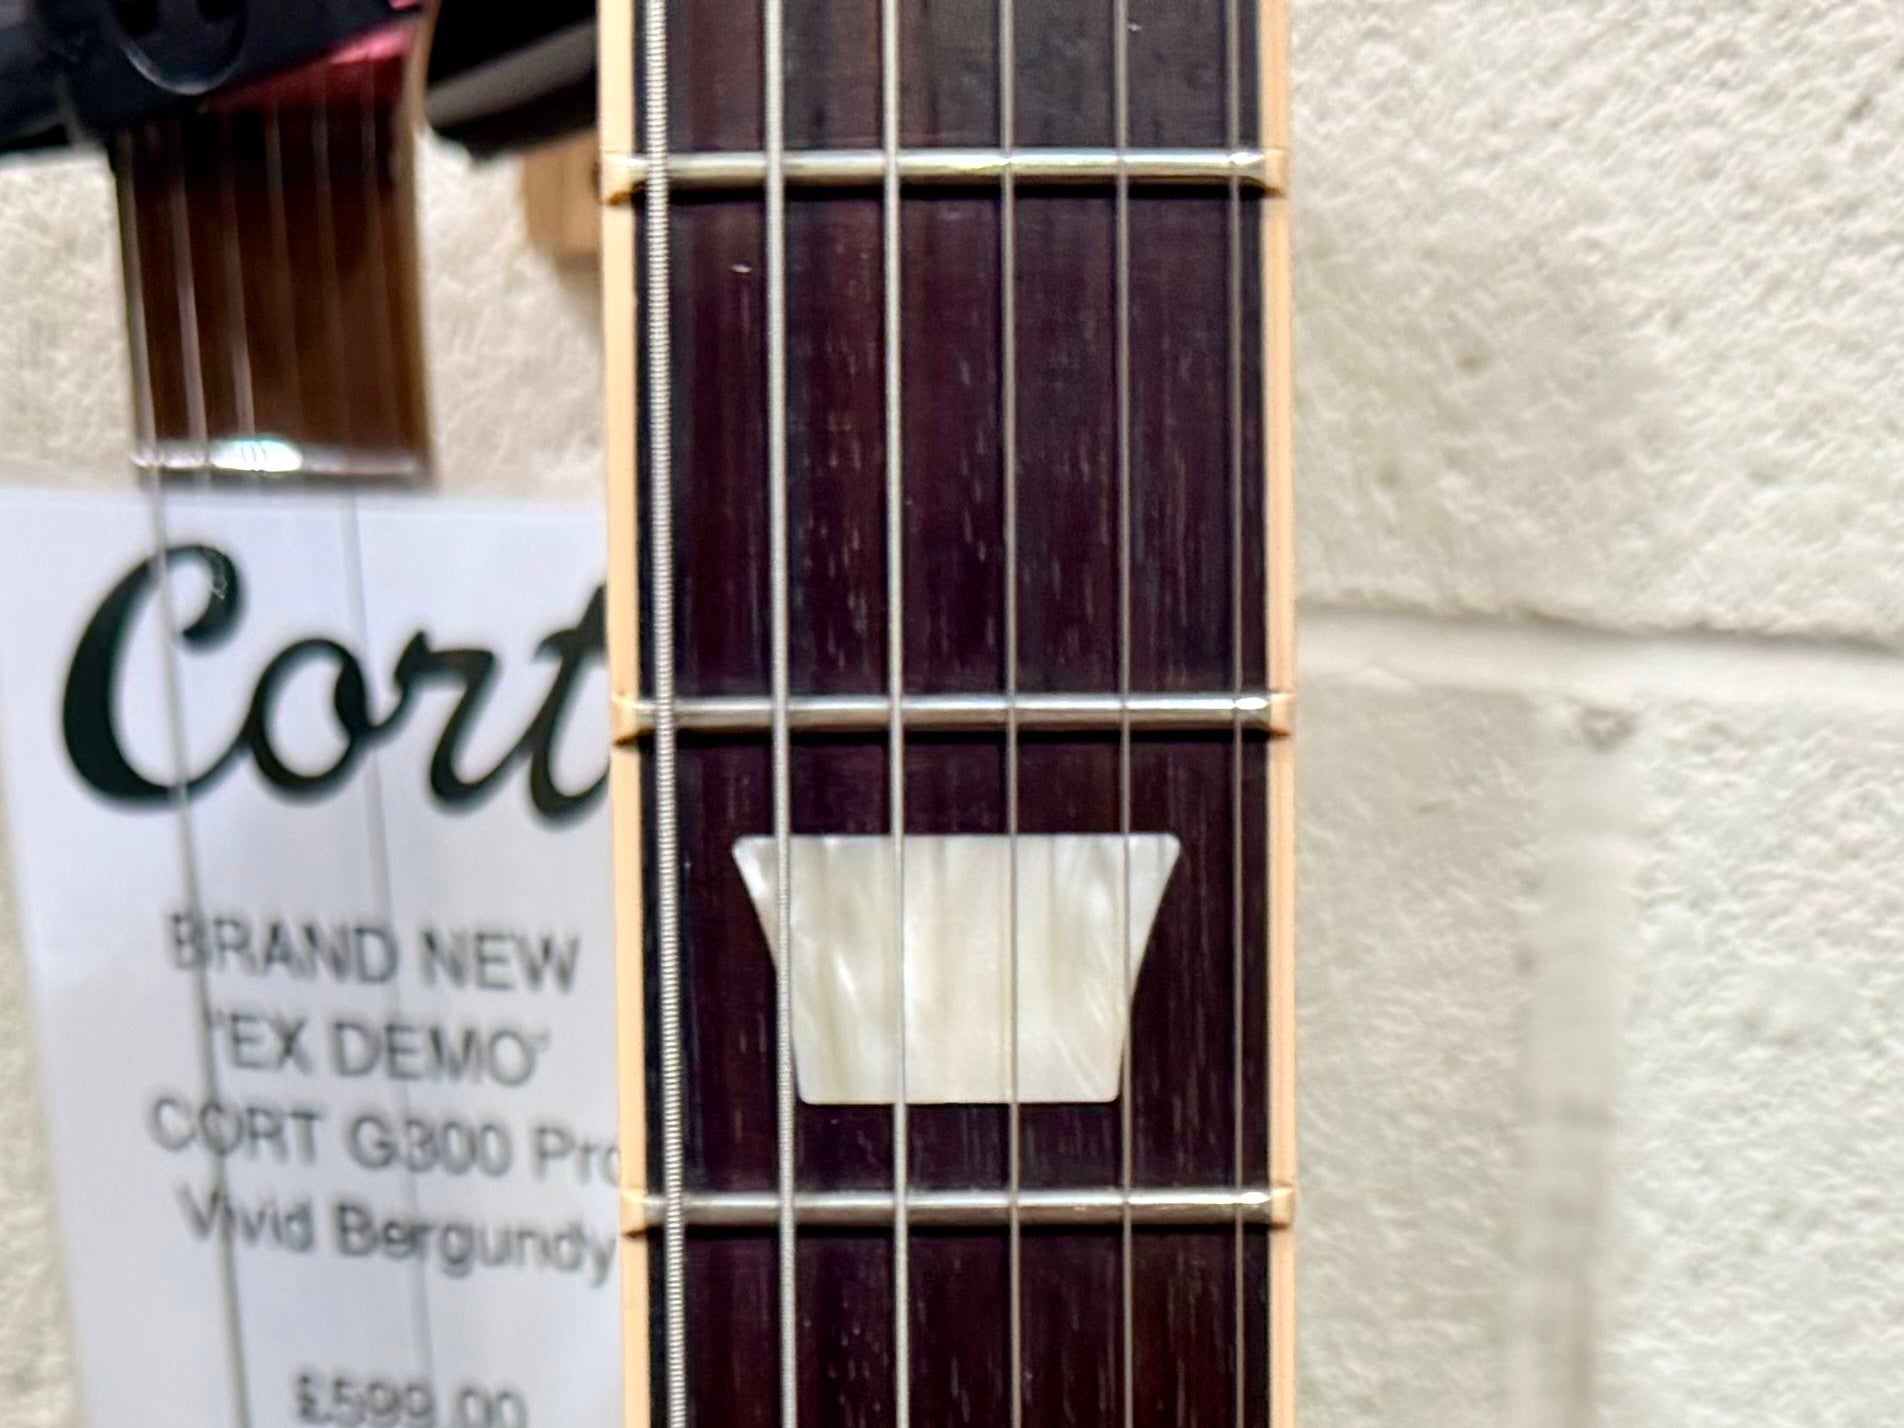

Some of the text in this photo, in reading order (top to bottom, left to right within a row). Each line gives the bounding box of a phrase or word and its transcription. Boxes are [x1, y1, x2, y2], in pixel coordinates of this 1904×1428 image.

[60, 543, 609, 826] Cort
[172, 909, 580, 994] BRAND NEW
[148, 1096, 322, 1166] CORT
[347, 1113, 513, 1178] G300
[178, 1182, 617, 1290] Vivid Bergundy
